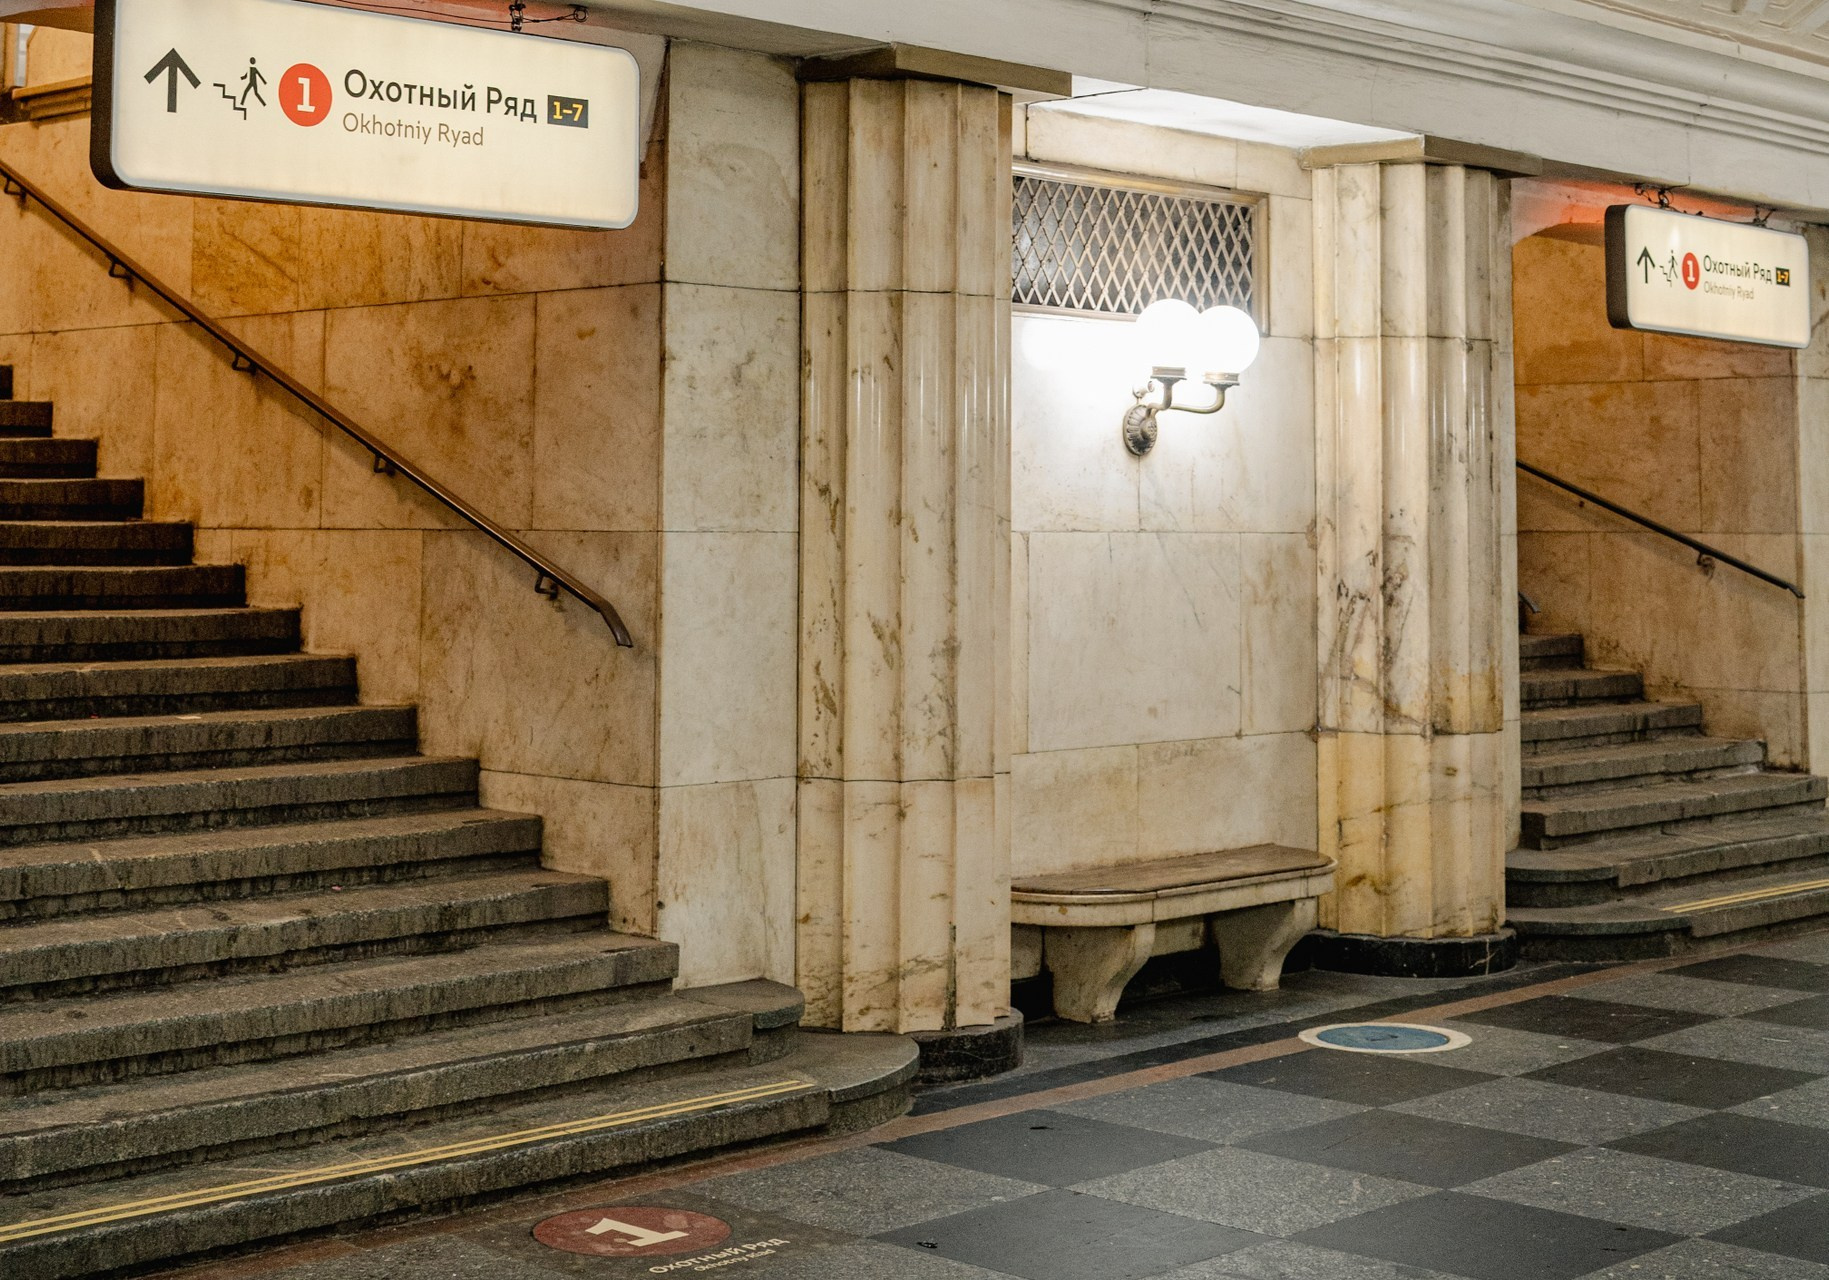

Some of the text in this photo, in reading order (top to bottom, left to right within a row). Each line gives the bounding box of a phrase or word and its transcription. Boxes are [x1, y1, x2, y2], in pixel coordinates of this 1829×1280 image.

[296, 77, 316, 113] 1
[344, 69, 476, 112] Охотный
[486, 86, 538, 123] Ряд
[343, 112, 484, 148] Okhotniy Ryad
[1687, 260, 1695, 282] 1
[1703, 254, 1751, 278] Охотный
[1753, 263, 1772, 284] Ряд
[585, 1217, 690, 1247] 1
